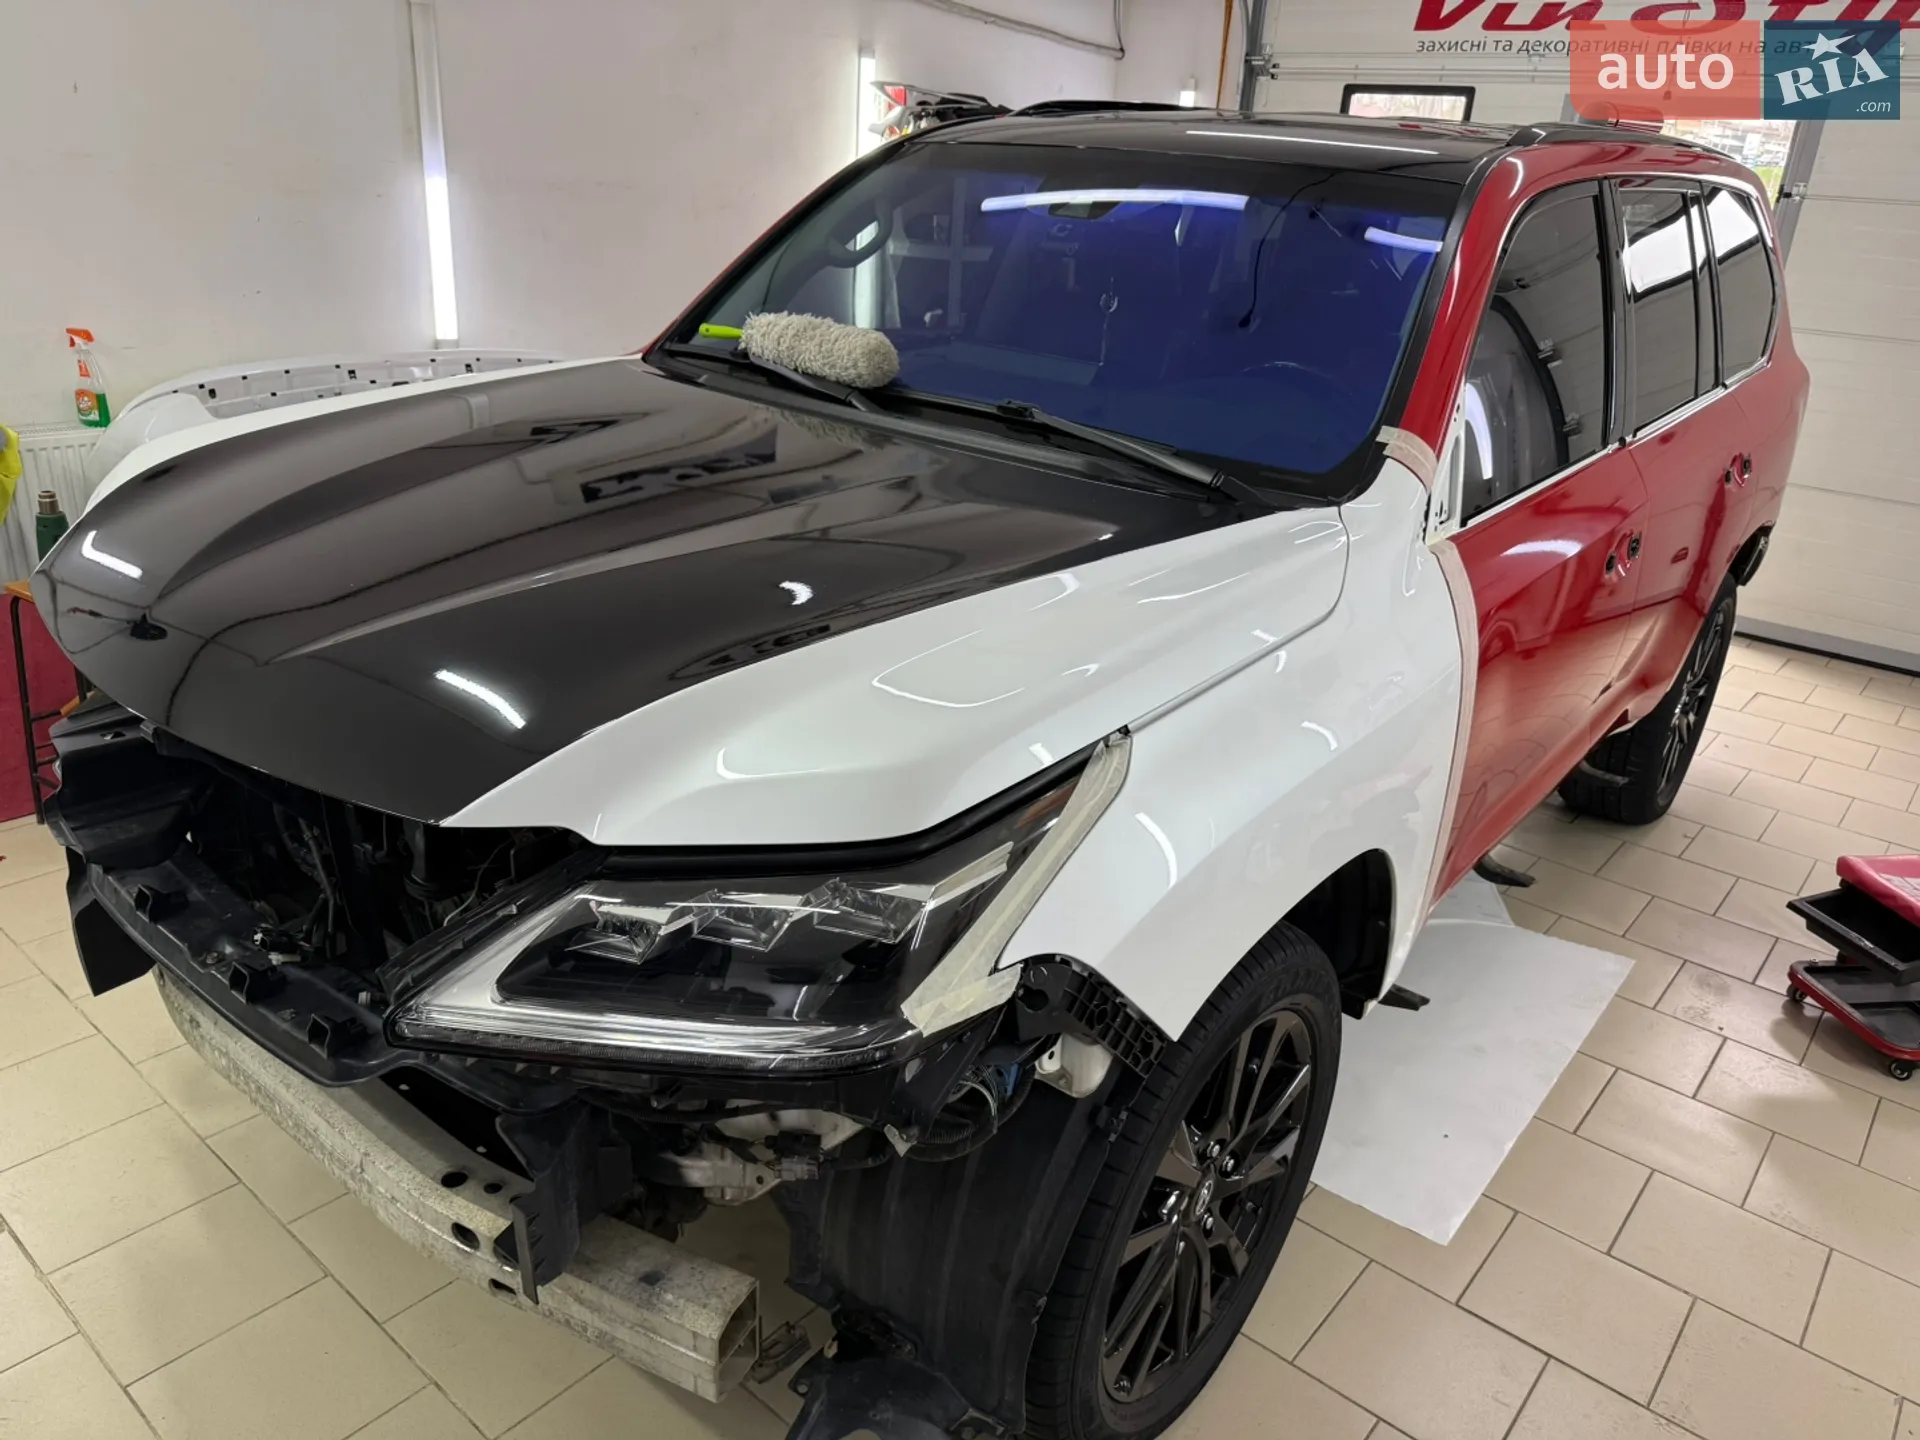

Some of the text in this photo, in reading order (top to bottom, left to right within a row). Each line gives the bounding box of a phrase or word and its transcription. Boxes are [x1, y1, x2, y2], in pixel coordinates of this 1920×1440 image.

[1416, 36, 1487, 53] захисні
[1493, 39, 1513, 52] та
[1517, 37, 1650, 56] декоративні
[1656, 36, 1732, 54] плівки
[1739, 40, 1767, 54] на
